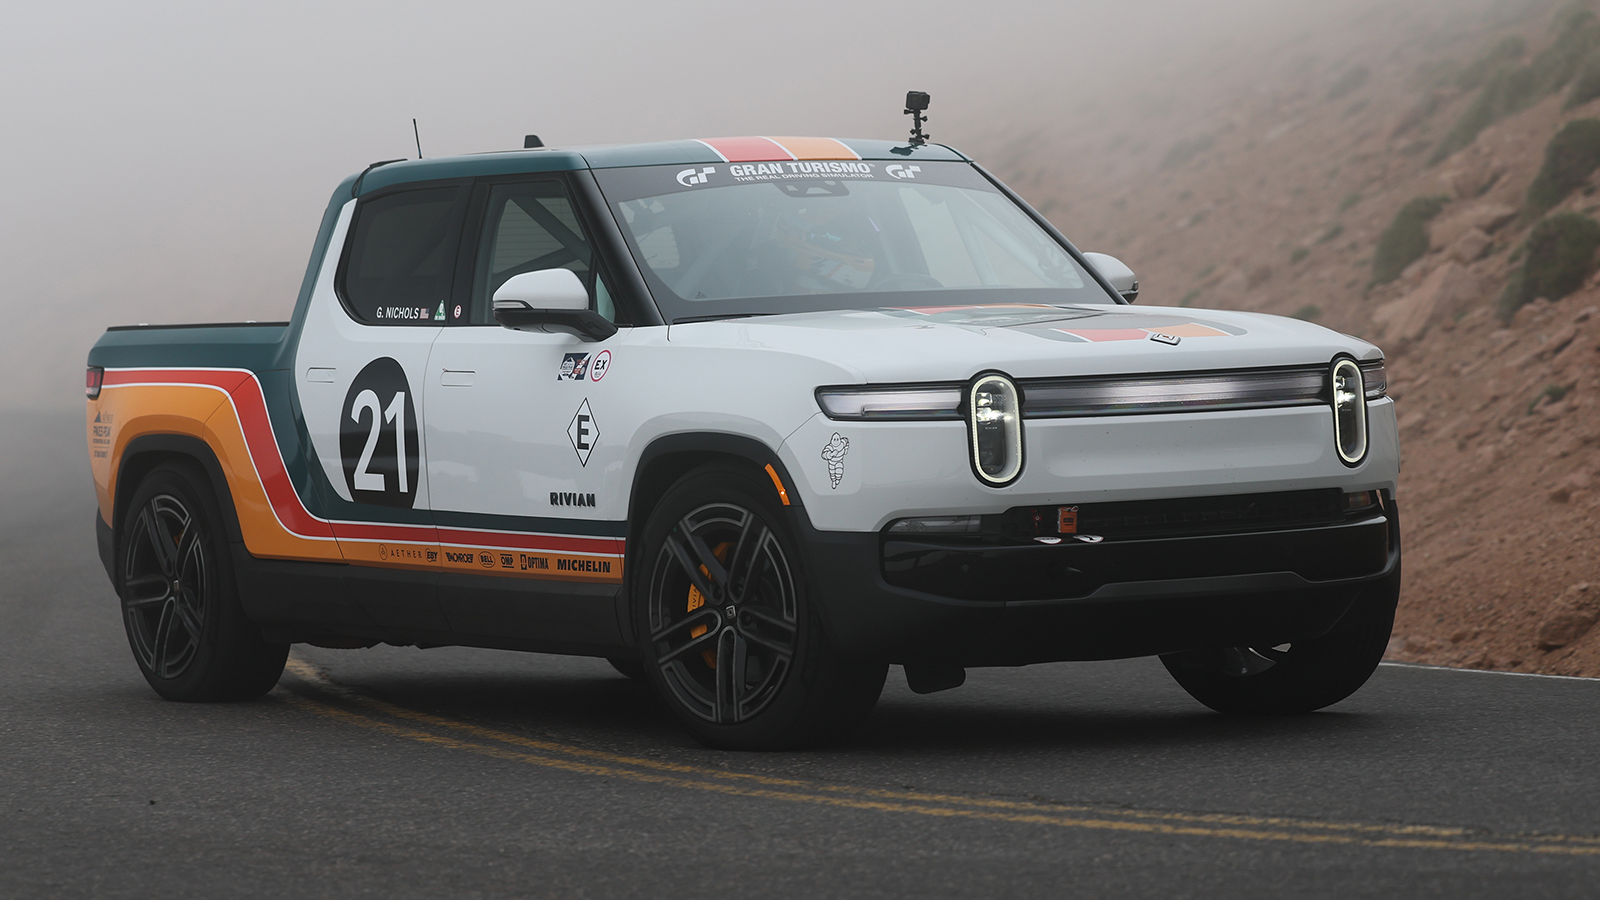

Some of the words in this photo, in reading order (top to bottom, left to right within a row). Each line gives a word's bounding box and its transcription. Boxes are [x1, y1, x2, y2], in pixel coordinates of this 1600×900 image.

[730, 163, 784, 177] GRAN
[376, 306, 384, 319] G.
[385, 306, 420, 319] NICHOLS
[594, 359, 608, 370] EX
[577, 414, 590, 450] E
[351, 389, 409, 493] 21
[549, 492, 596, 507] RIVIAN
[390, 549, 422, 559] AETHER
[480, 555, 494, 564] BELL
[500, 556, 514, 566] OMP
[527, 557, 549, 570] OPTIMA
[557, 559, 611, 573] MICHELIN
